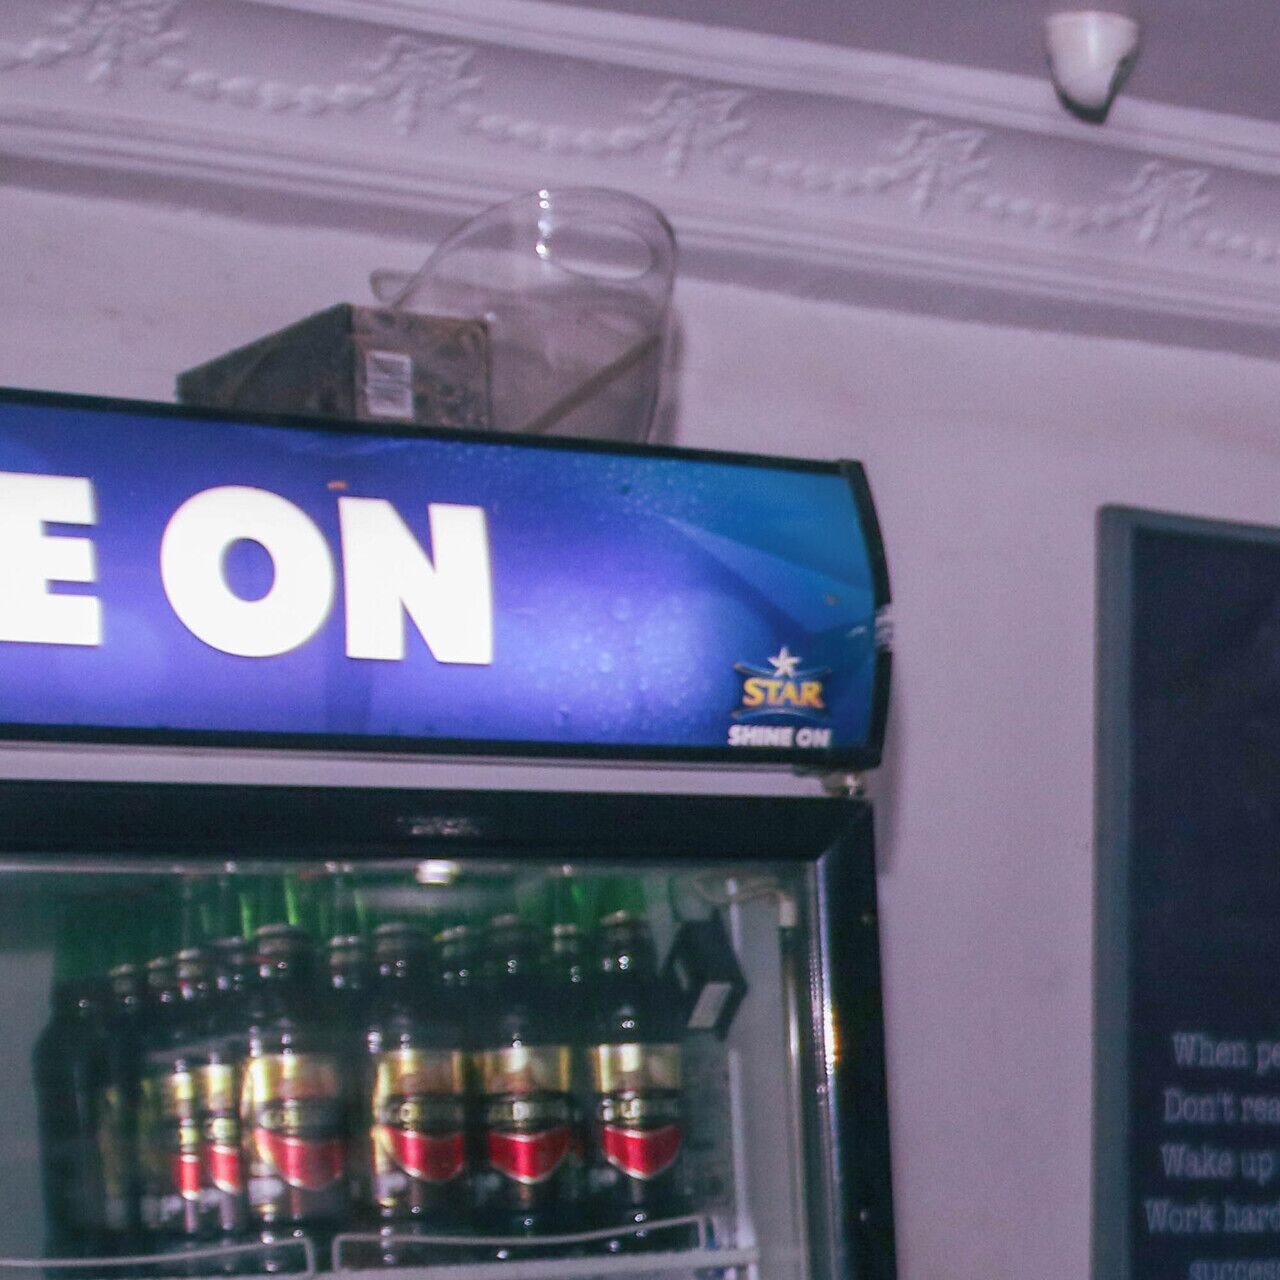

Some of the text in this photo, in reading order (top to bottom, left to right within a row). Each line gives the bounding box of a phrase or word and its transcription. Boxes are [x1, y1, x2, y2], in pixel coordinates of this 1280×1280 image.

[0, 471, 493, 665] E ON
[741, 677, 825, 709] STAR
[727, 724, 831, 748] SHINE ON
[1172, 1032, 1249, 1068] When
[1164, 1087, 1235, 1124] Don't
[1160, 1143, 1234, 1178] Wake
[1241, 1150, 1275, 1185] up
[1145, 1198, 1217, 1233] Work
